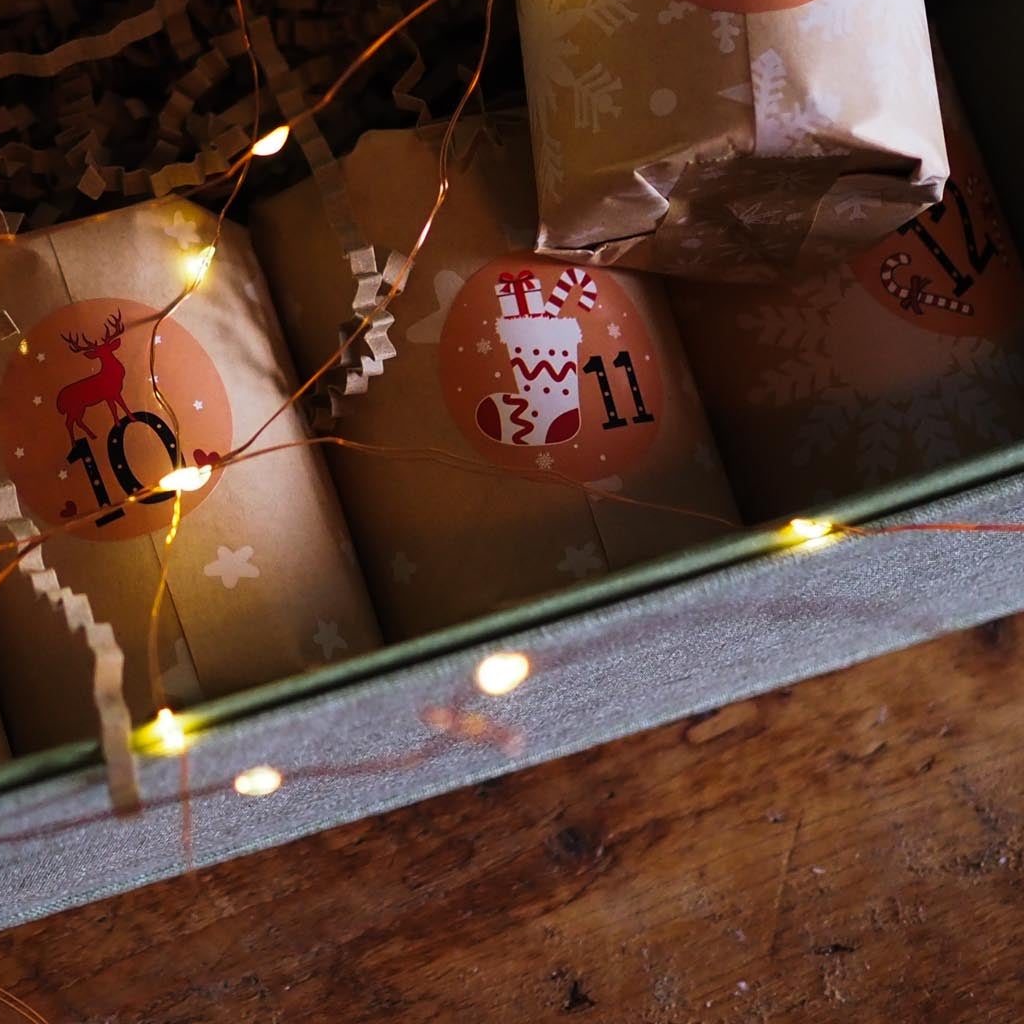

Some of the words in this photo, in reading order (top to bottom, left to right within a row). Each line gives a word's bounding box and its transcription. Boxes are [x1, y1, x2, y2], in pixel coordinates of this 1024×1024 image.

[896, 178, 1000, 298] 12
[582, 350, 655, 430] 11
[66, 410, 187, 528] 10
